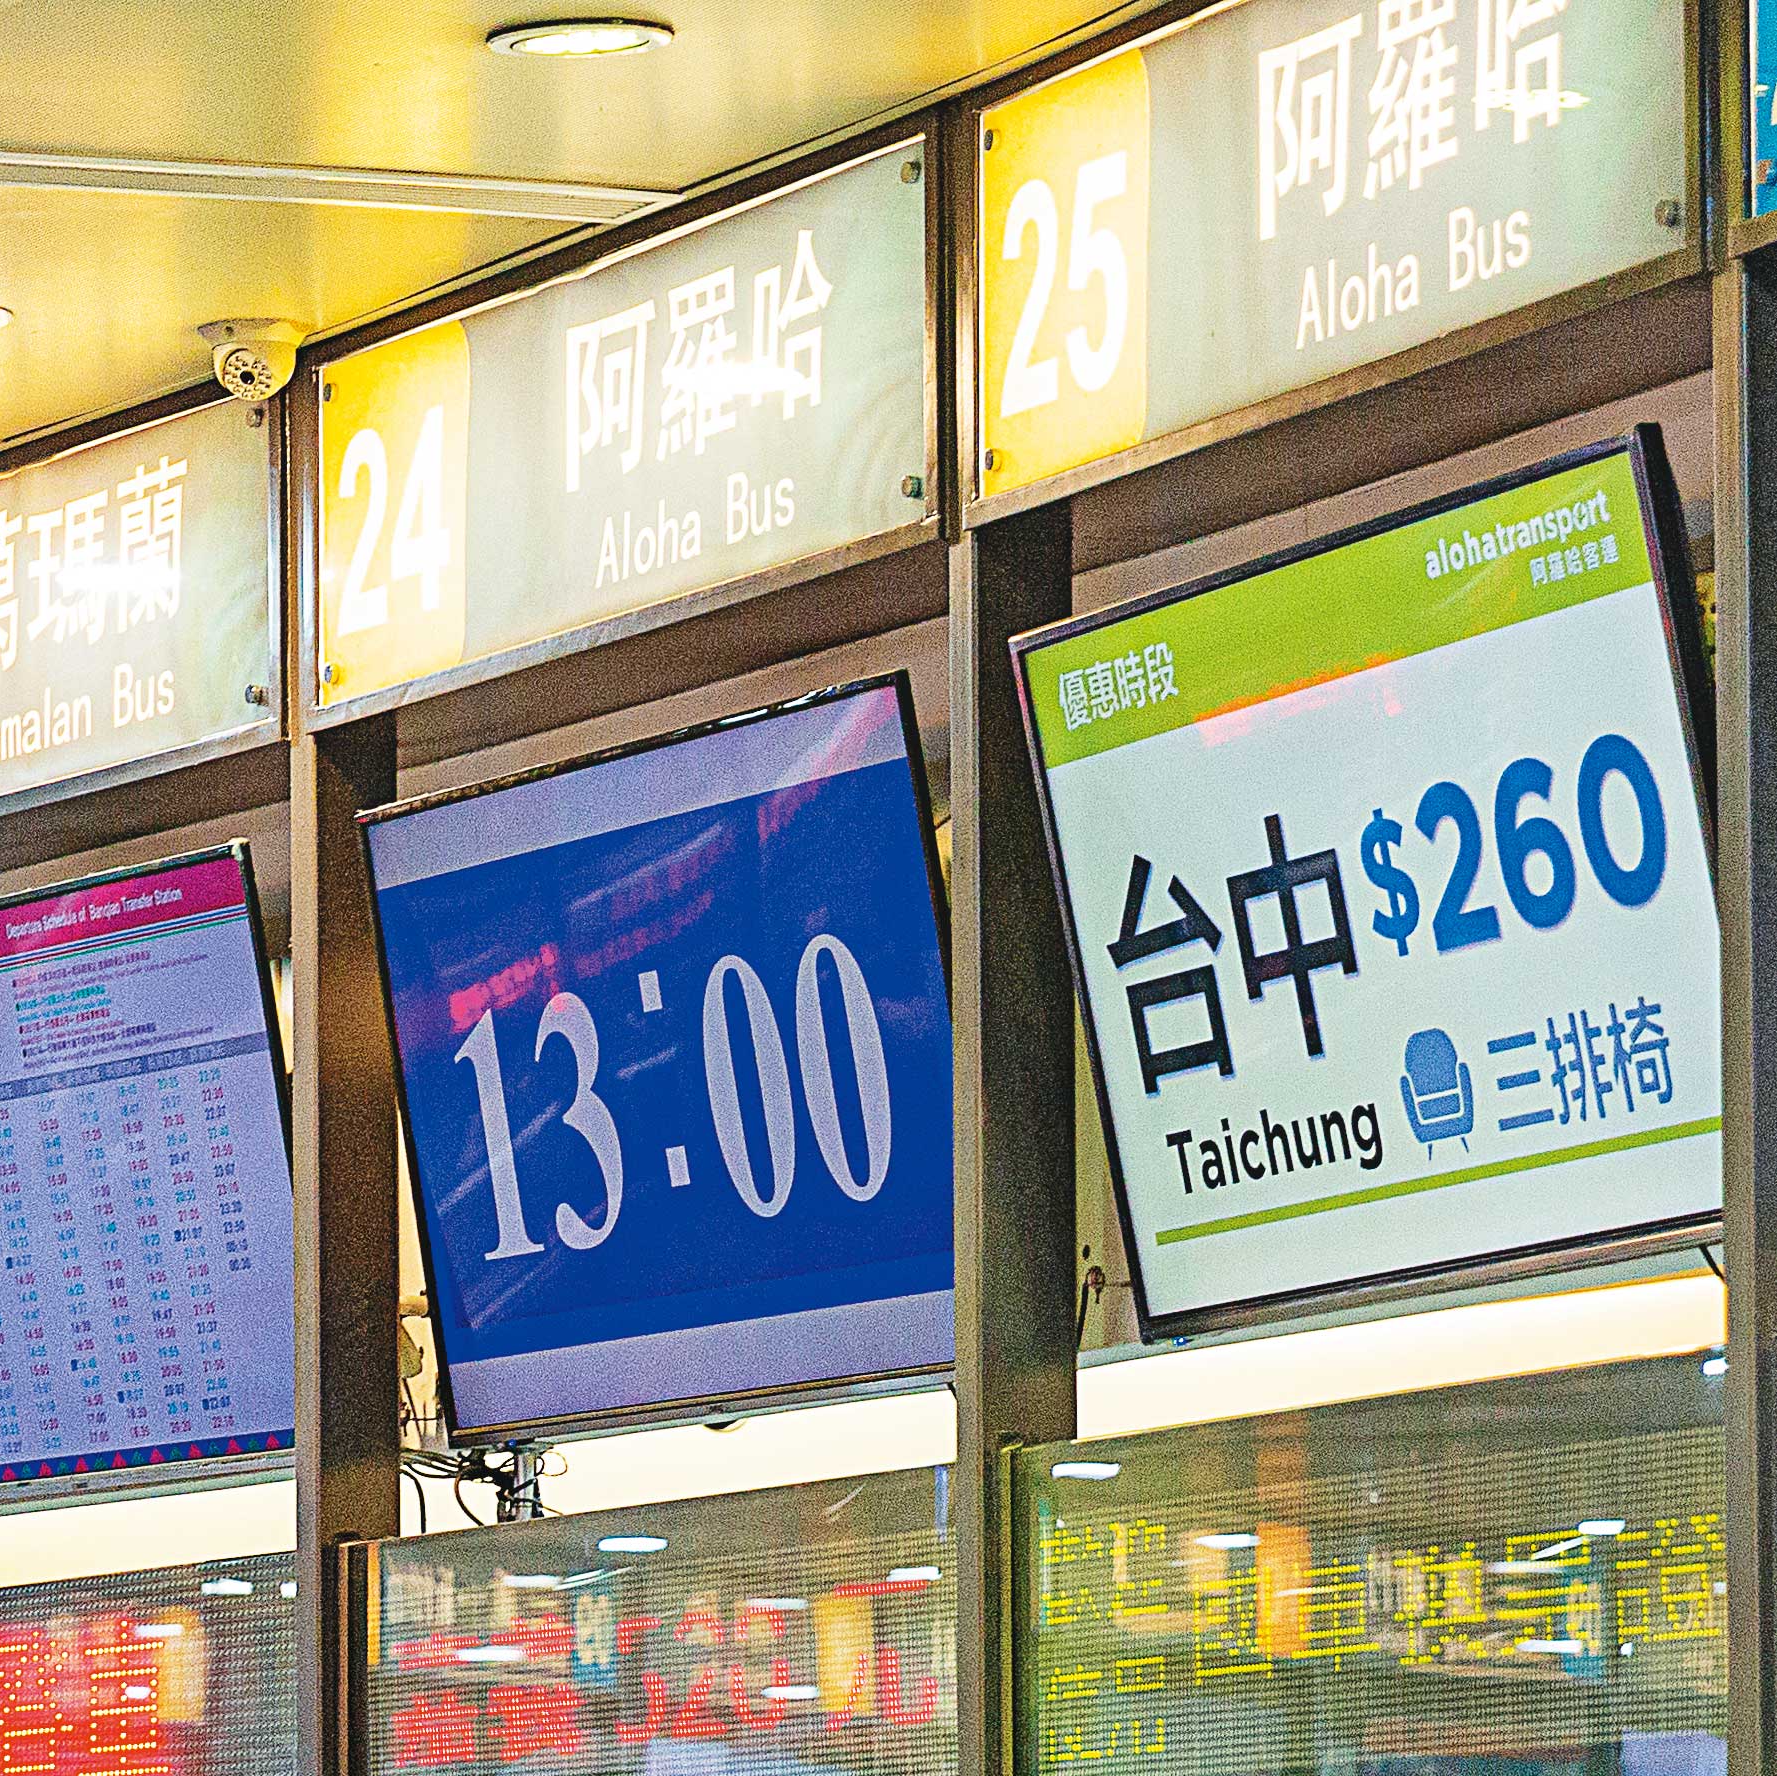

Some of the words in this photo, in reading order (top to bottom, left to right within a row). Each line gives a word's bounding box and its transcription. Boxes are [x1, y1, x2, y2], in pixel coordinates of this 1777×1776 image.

[564, 229, 833, 493] 阿羅哈
[1000, 150, 1127, 418] 25
[1297, 241, 1419, 350] Aloha
[1448, 205, 1532, 292] Bus
[337, 403, 449, 638] 24
[595, 498, 701, 589] Aloha
[727, 471, 796, 546] Bus
[1424, 489, 1611, 580] alohatransport
[1529, 535, 1621, 588] 阿羅哈客運
[113, 662, 175, 729] Bus
[1058, 642, 1181, 732] 優惠時段
[1106, 813, 1361, 1098] 台中
[1360, 732, 1668, 958] $260
[453, 932, 892, 1261] 13:00
[1167, 1096, 1383, 1195] Taichung
[1485, 996, 1674, 1134] 三排椅
